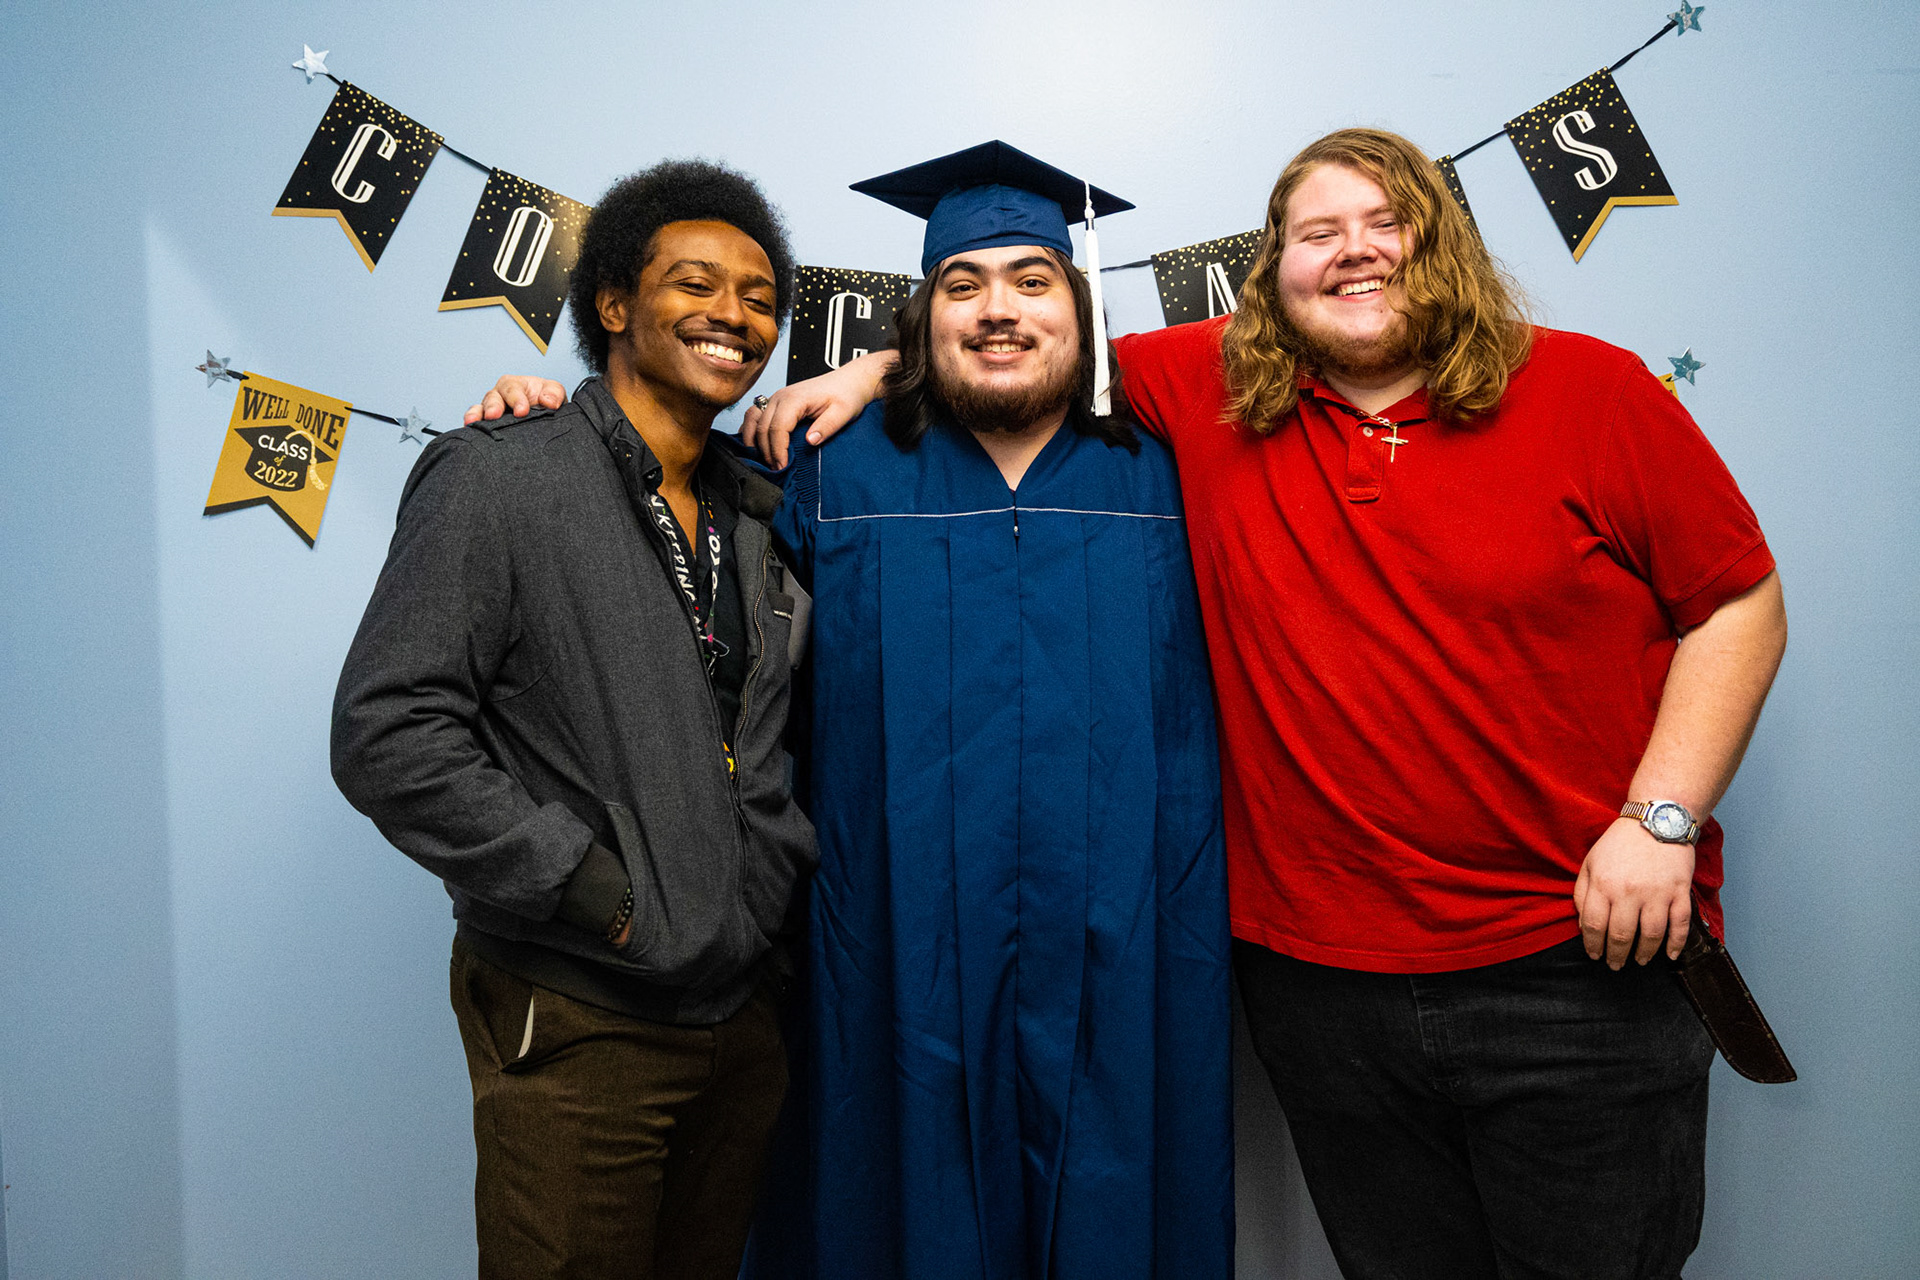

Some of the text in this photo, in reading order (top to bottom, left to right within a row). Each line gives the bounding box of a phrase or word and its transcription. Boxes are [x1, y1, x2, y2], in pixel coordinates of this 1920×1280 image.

[331, 123, 397, 203] C
[494, 206, 554, 287] O
[1552, 110, 1618, 191] S
[242, 386, 346, 451] WELL DONE
[257, 434, 309, 461] CLASS
[273, 454, 287, 467] of
[253, 460, 299, 488] 2022
